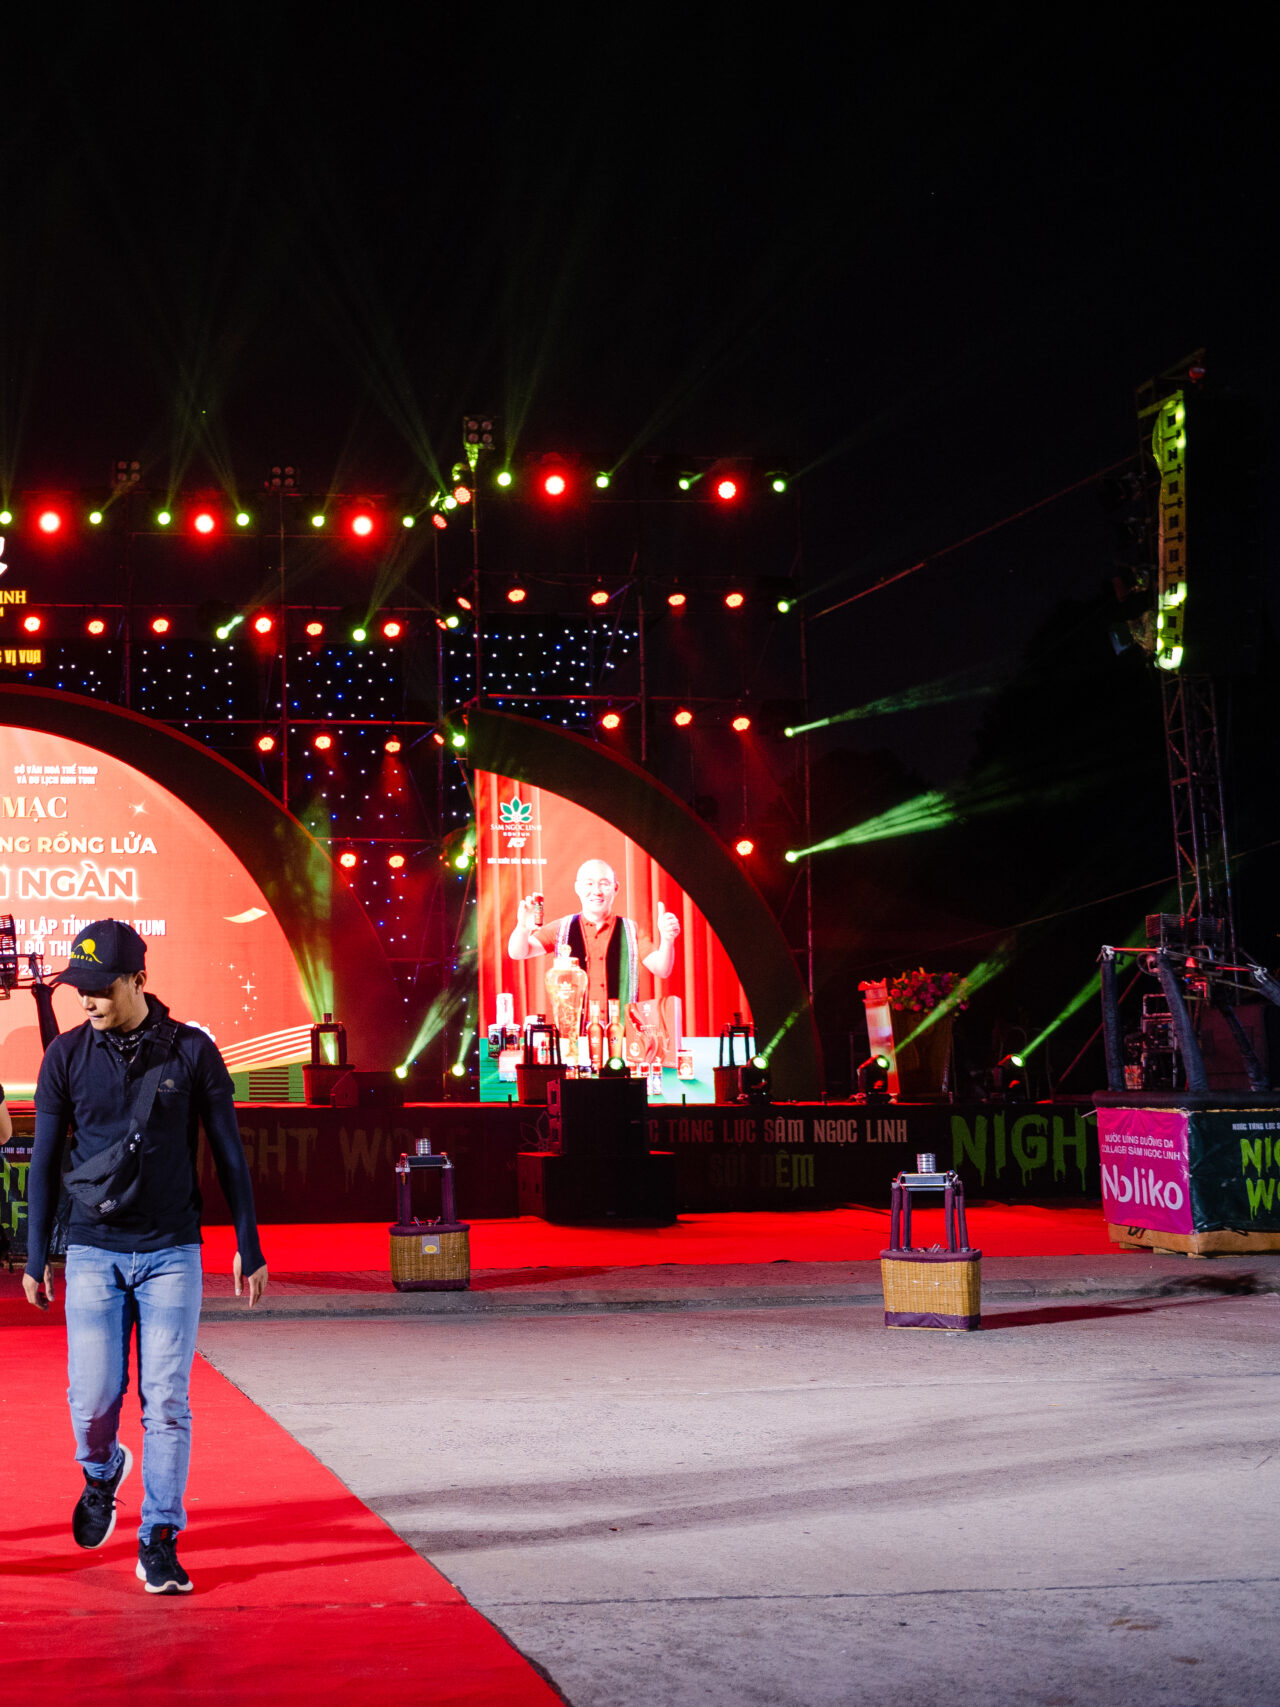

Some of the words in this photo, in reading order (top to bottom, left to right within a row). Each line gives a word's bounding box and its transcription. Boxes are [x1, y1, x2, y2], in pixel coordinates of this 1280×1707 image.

[5, 650, 17, 666] VỊ
[19, 650, 41, 665] VUA
[1, 797, 67, 822] MẠC
[111, 831, 157, 854] LỬA
[19, 861, 136, 900] NGÀN
[133, 919, 166, 936] TUM
[764, 1115, 805, 1143] SÂM
[813, 1119, 858, 1147] NGỌC
[866, 1119, 908, 1143] LINH
[950, 1107, 1097, 1191] NIGH
[1102, 1163, 1184, 1211] Noliko
